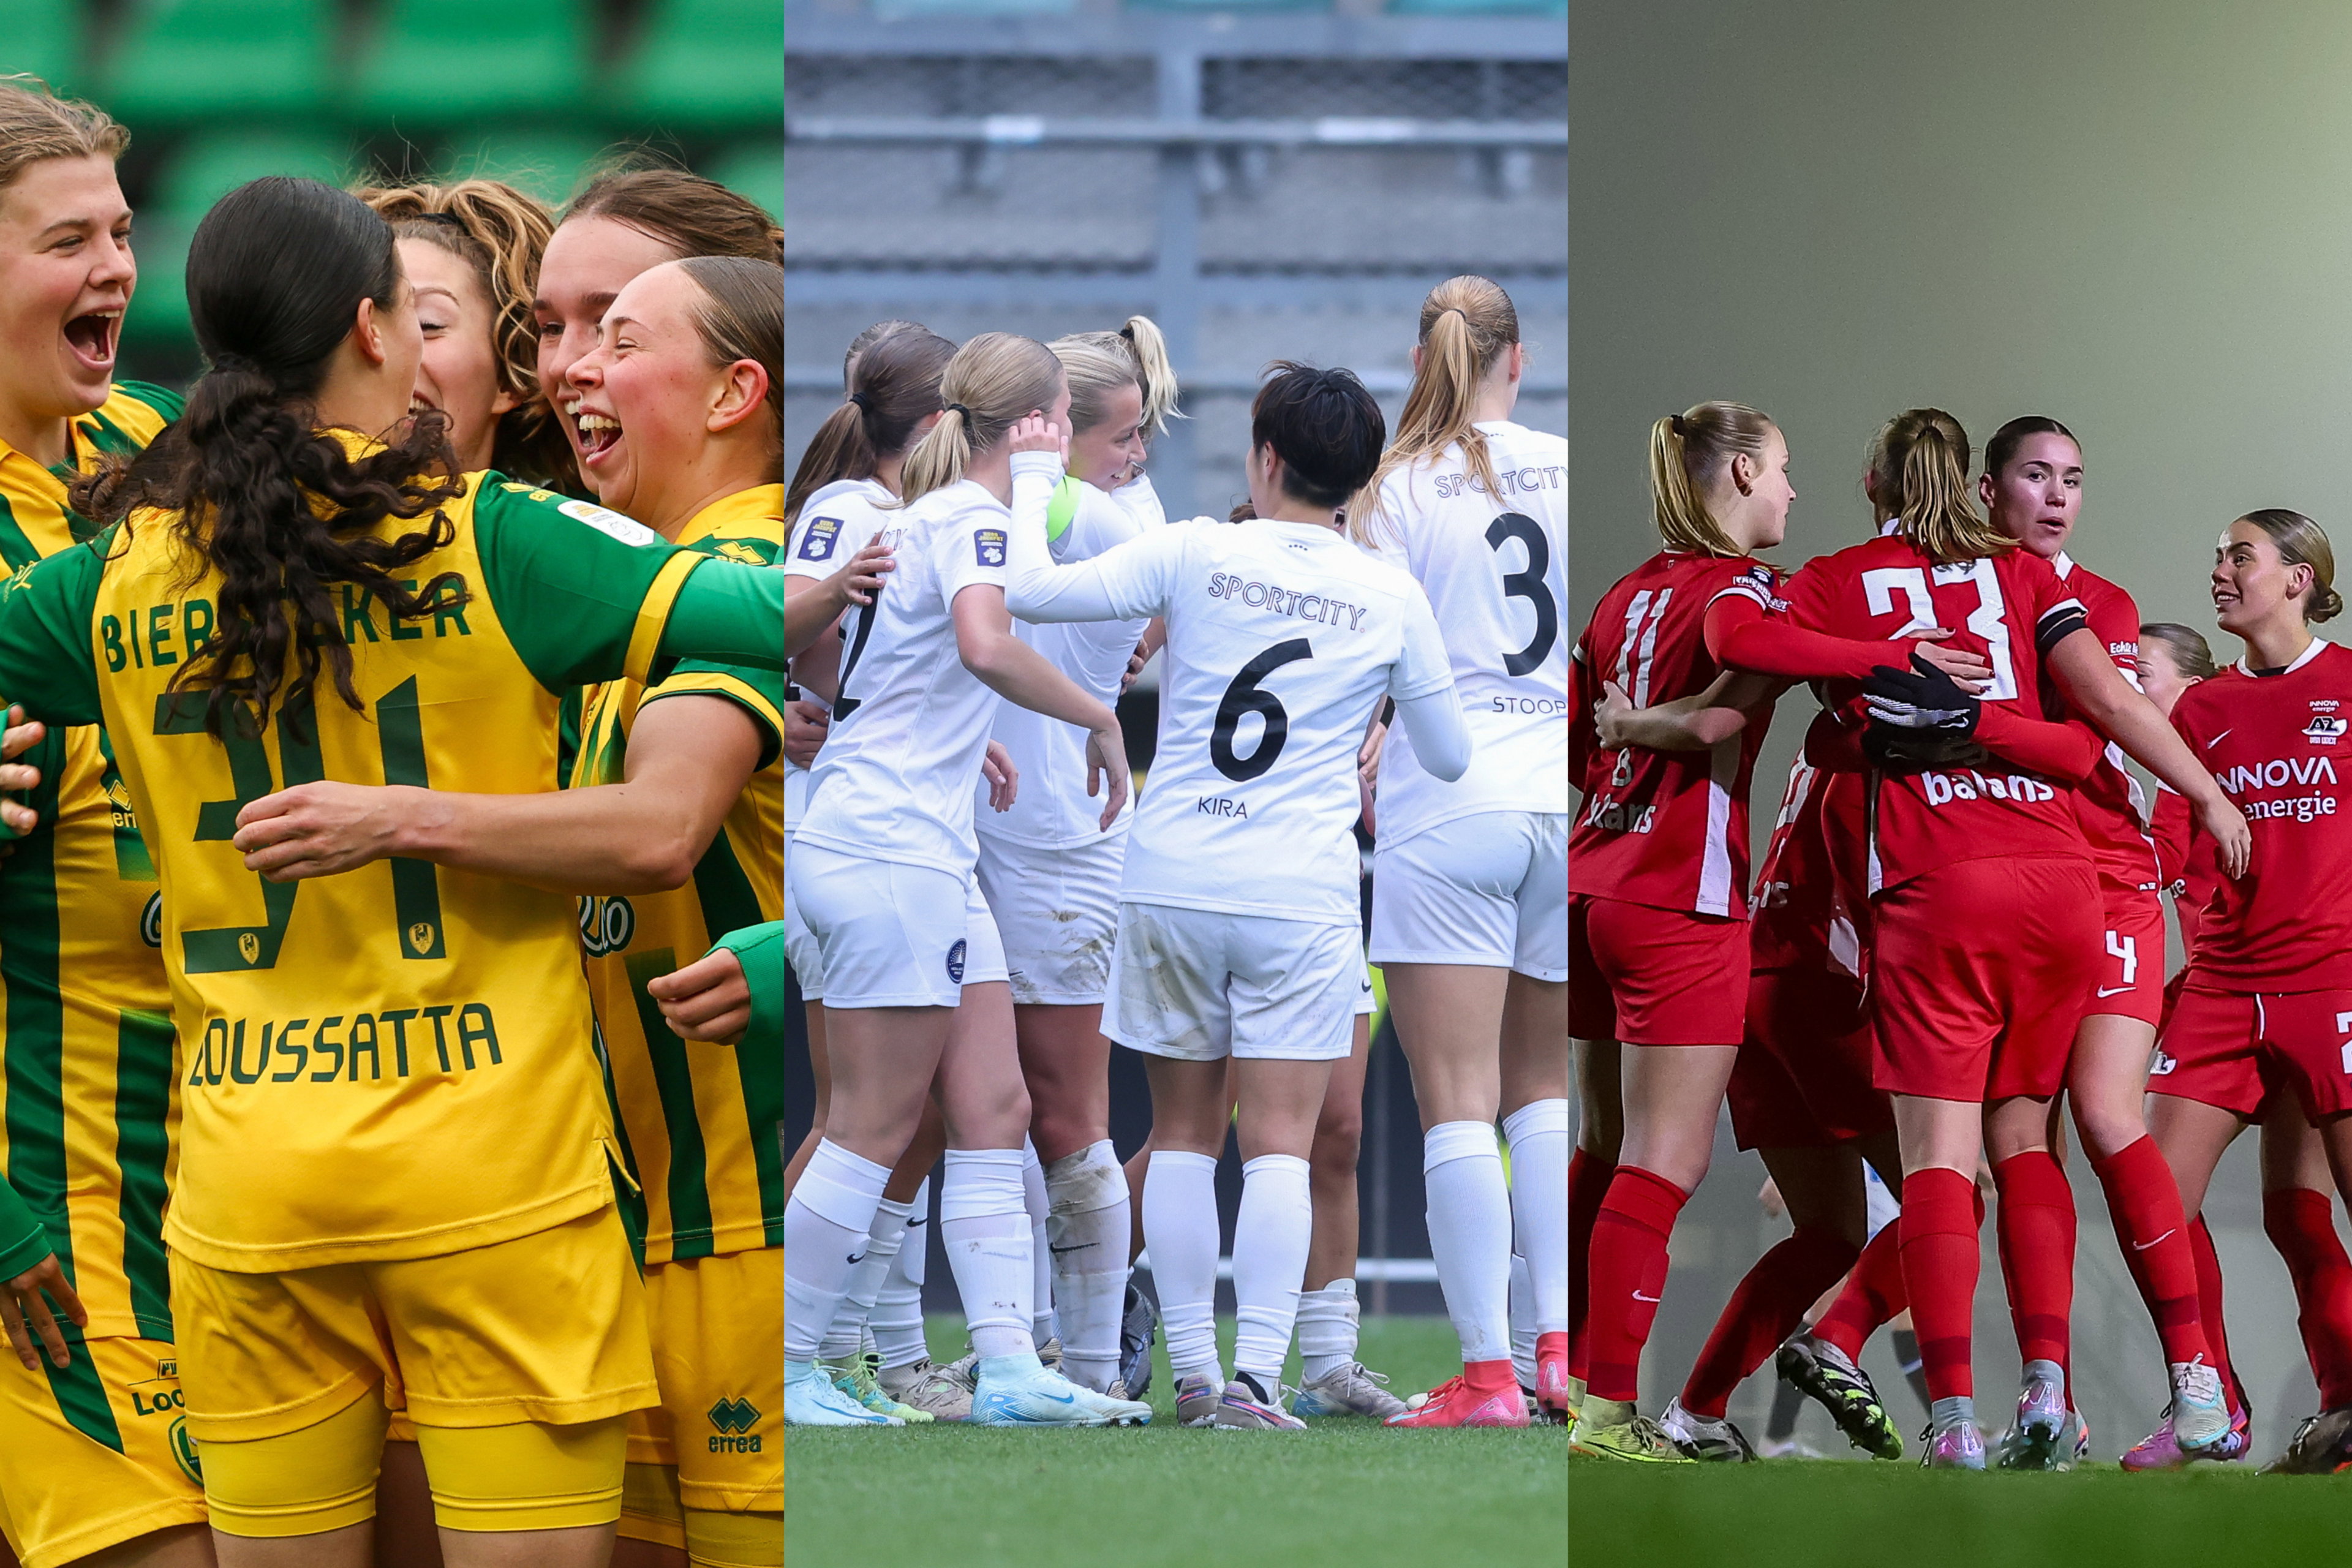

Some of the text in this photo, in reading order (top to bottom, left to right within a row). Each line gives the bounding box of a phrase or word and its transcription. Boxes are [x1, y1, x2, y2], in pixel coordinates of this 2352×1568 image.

[1208, 572, 1366, 631] SPORTCITY
[1485, 512, 1558, 677] 3
[1210, 638, 1313, 782] 6
[1492, 696, 1566, 714] STOOP
[2308, 717, 2339, 733] AZ
[1921, 769, 2054, 806] balans
[2216, 756, 2338, 794] NNOVA
[1197, 796, 1248, 820] KIRA
[2106, 930, 2137, 984] 4
[709, 1435, 761, 1453] errea
